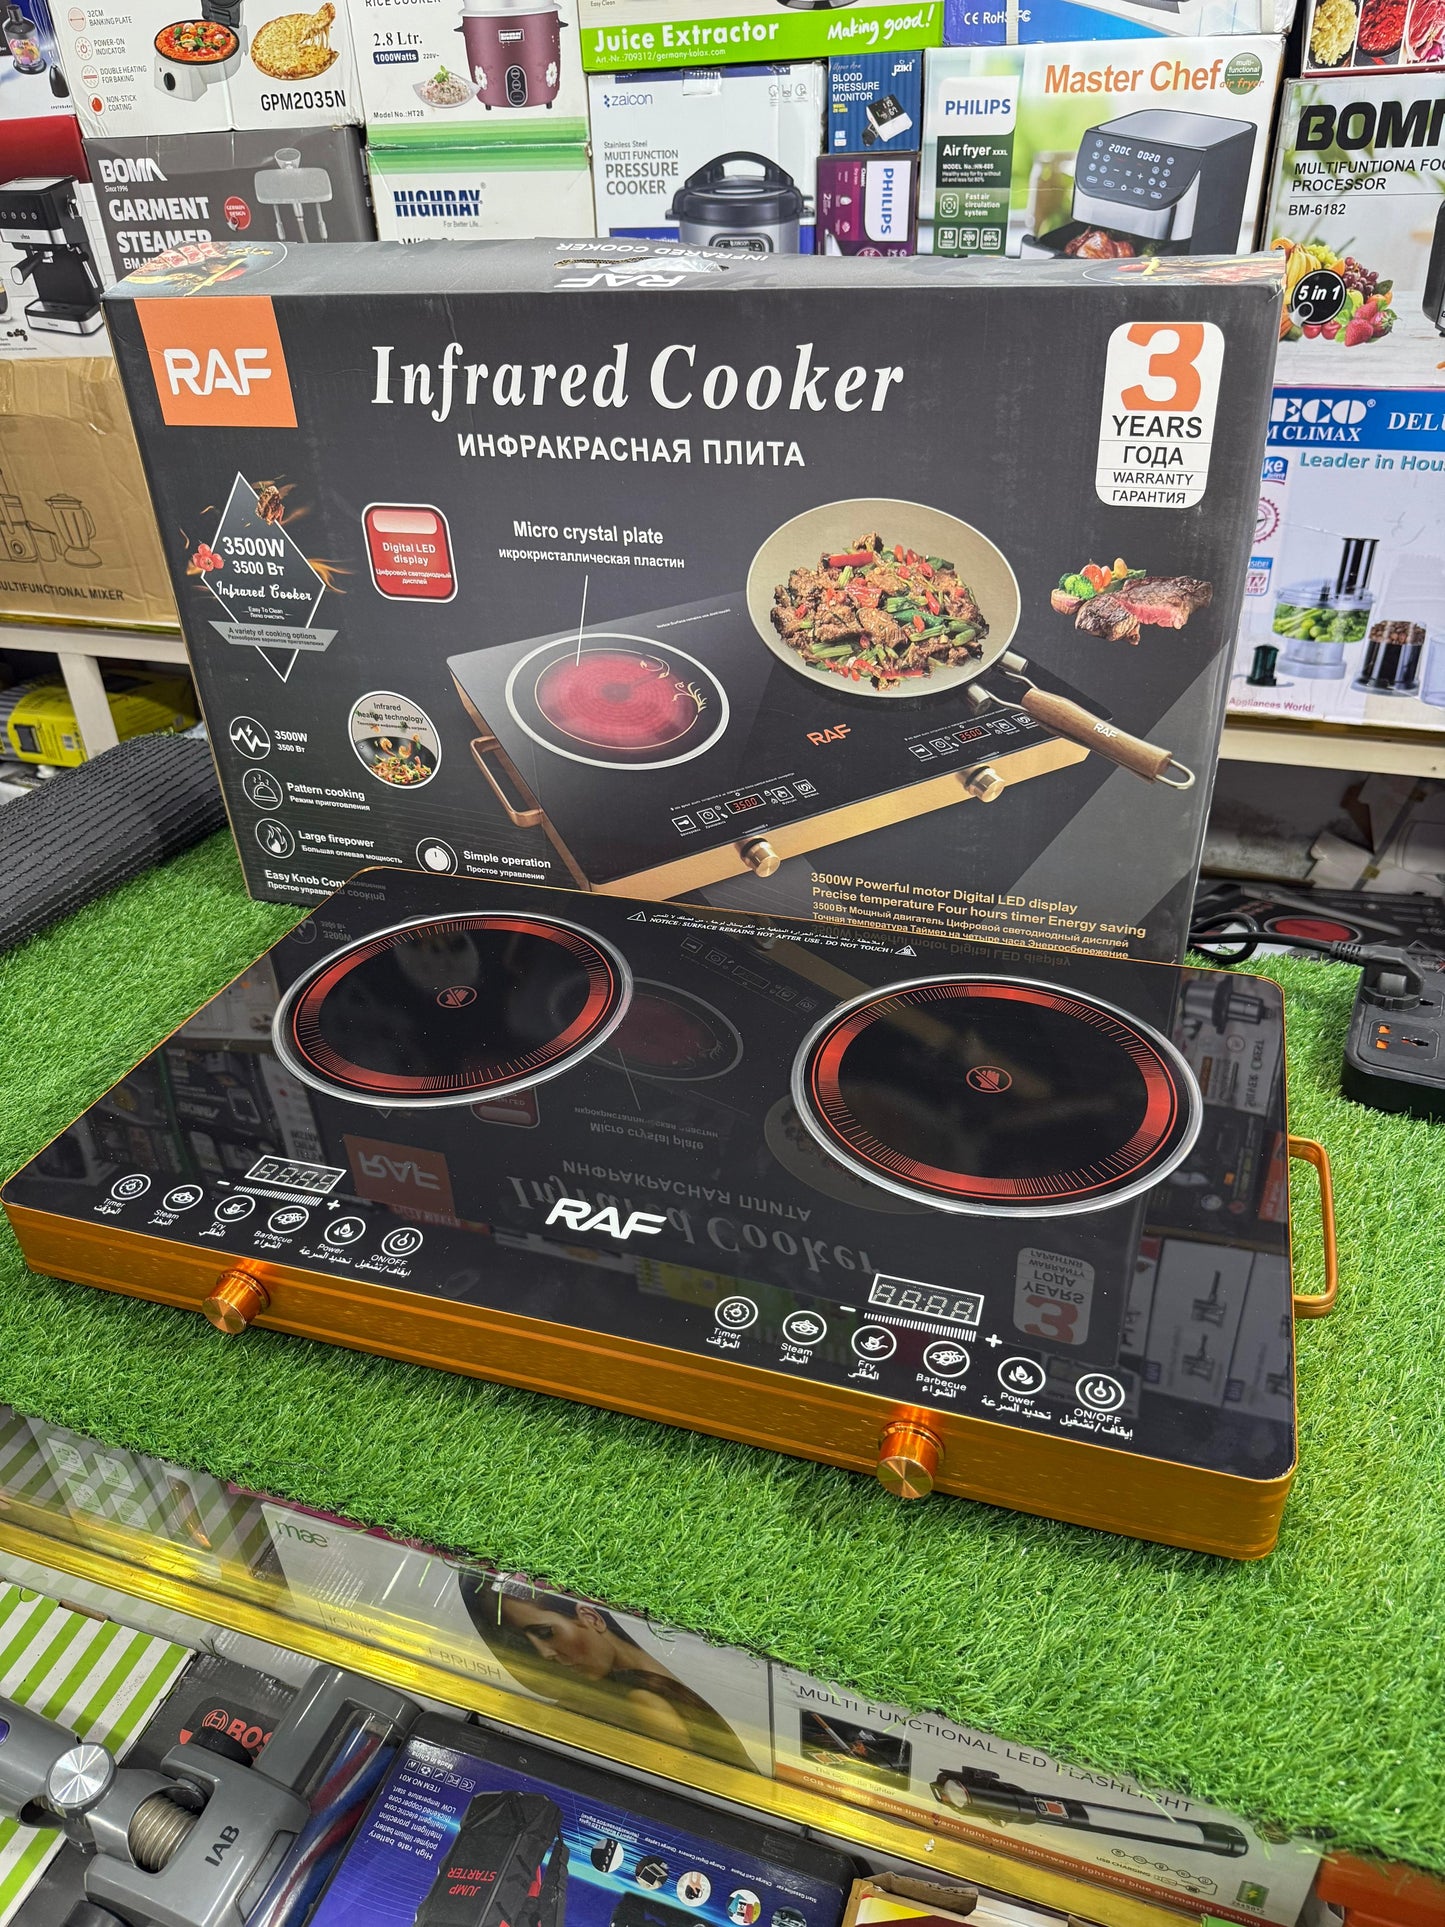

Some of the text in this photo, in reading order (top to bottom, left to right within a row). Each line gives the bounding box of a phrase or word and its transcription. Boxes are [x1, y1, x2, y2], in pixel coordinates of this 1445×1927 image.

[88, 9, 103, 18] 32CM
[89, 16, 132, 26] BANKING PLATE
[828, 4, 935, 45] Making good!
[93, 38, 125, 47] POWER-ON
[374, 31, 422, 46] 2.8 Ltr.
[595, 21, 779, 53] Juice Extractor
[95, 46, 126, 55] INDICATOR
[376, 53, 417, 62] 1000Watts
[100, 65, 147, 74] DOUBLE HEATING
[1045, 59, 1223, 94] Master Chef
[102, 73, 135, 83] FOR BAKING
[833, 73, 862, 82] BLOOD
[833, 82, 879, 92] PRESSURE
[106, 94, 137, 103] NON-STICK
[261, 90, 346, 111] GPM2035N
[612, 92, 653, 106] zaicon
[833, 93, 873, 102] MONITOR
[108, 102, 132, 112] COATING
[945, 99, 1011, 115] PHILIPS
[633, 140, 647, 148] Steel
[943, 144, 991, 158] Air fryer
[604, 150, 678, 160] MULTI FUNCTION
[99, 158, 168, 183] BOMA
[606, 162, 679, 178] PRESSURE
[1295, 159, 1415, 175] MULTIFUNTIONA
[607, 180, 666, 195] COOKER
[1292, 178, 1386, 192] PROCESSOR
[393, 190, 480, 217] HIGHRAY
[881, 168, 894, 234] PHILIPS
[108, 197, 209, 222] GARMENT
[1289, 204, 1346, 216] BM-6182
[556, 243, 769, 261] INFRARED COOKER
[554, 274, 687, 288] RAF
[1298, 285, 1342, 300] 5 in 1
[163, 348, 272, 395] RAF
[1121, 324, 1204, 412] 3
[371, 342, 904, 423] Infrared Cooker
[1112, 415, 1203, 438] YEARS
[1282, 426, 1362, 442] CLIMAX
[457, 433, 805, 467] ИНФРАКРАСНАЯ ПЛИТА
[1124, 446, 1184, 468] ГОДА
[1300, 452, 1394, 470] Leader in
[1113, 472, 1194, 485] WARRANTY
[1112, 490, 1186, 504] ГАРАНТИЯ
[513, 520, 664, 546] Micro crystal plate
[223, 537, 284, 557] 3500W
[383, 542, 435, 554] Digital LED
[394, 555, 428, 566] display
[499, 549, 685, 568] икрокристаллическая пластин
[233, 561, 263, 575] 3500
[89, 589, 124, 600] MIXER
[217, 581, 312, 600] Infrared Cooker
[234, 629, 256, 637] variety
[265, 630, 291, 639] cooking
[292, 632, 316, 640] options
[373, 703, 401, 711] Infrared
[1229, 696, 1315, 712] Appliances World!
[385, 714, 424, 724] technology
[274, 730, 308, 743] 3500W
[806, 723, 852, 747] RAF
[959, 728, 982, 741] 3500
[1093, 721, 1118, 740] RAF
[287, 783, 365, 801] Pattern cooking
[733, 798, 758, 811] 3500
[299, 830, 375, 849] Large firepower
[463, 850, 551, 869] Simple operation
[265, 869, 320, 886] Easy Knob
[467, 865, 545, 880] Простое управление
[811, 872, 1078, 915] 3500W Powerful motor Digital LED display
[812, 886, 1146, 938] Precise temperature Four hours timer Energy saving
[849, 905, 891, 918] Мощный
[893, 912, 944, 926] двигатель
[946, 918, 1000, 933] Цифровой
[1003, 926, 1080, 942] светодиодный
[1082, 936, 1129, 948] дисплей
[103, 1197, 125, 1208] Timer
[154, 1209, 179, 1221] Steam
[545, 1197, 667, 1240] RAF
[211, 1221, 225, 1230] Fry
[254, 1230, 293, 1244] Barbecue
[317, 1243, 344, 1255] Power
[371, 1254, 408, 1266] ON/OFF
[714, 1328, 741, 1340] Timer
[706, 1335, 740, 1349] المؤقت
[780, 1343, 813, 1356] Steam
[779, 1353, 808, 1365] البخار
[858, 1360, 876, 1371] Fry
[916, 1373, 967, 1391] Barbecue
[921, 1384, 956, 1398] الشواء
[1001, 1392, 1035, 1406] Power
[981, 1395, 1052, 1420] تحديد السرعة
[1073, 1408, 1122, 1424] ON/OFF
[799, 1685, 1194, 1814] MULTI FUNCTIONAL LED FLASHLIGHT
[399, 1774, 441, 1793] ITEM NO.K01
[368, 1830, 433, 1860] High rate battery
[447, 1867, 497, 1882] STARTER
[449, 1886, 481, 1897] JUMP
